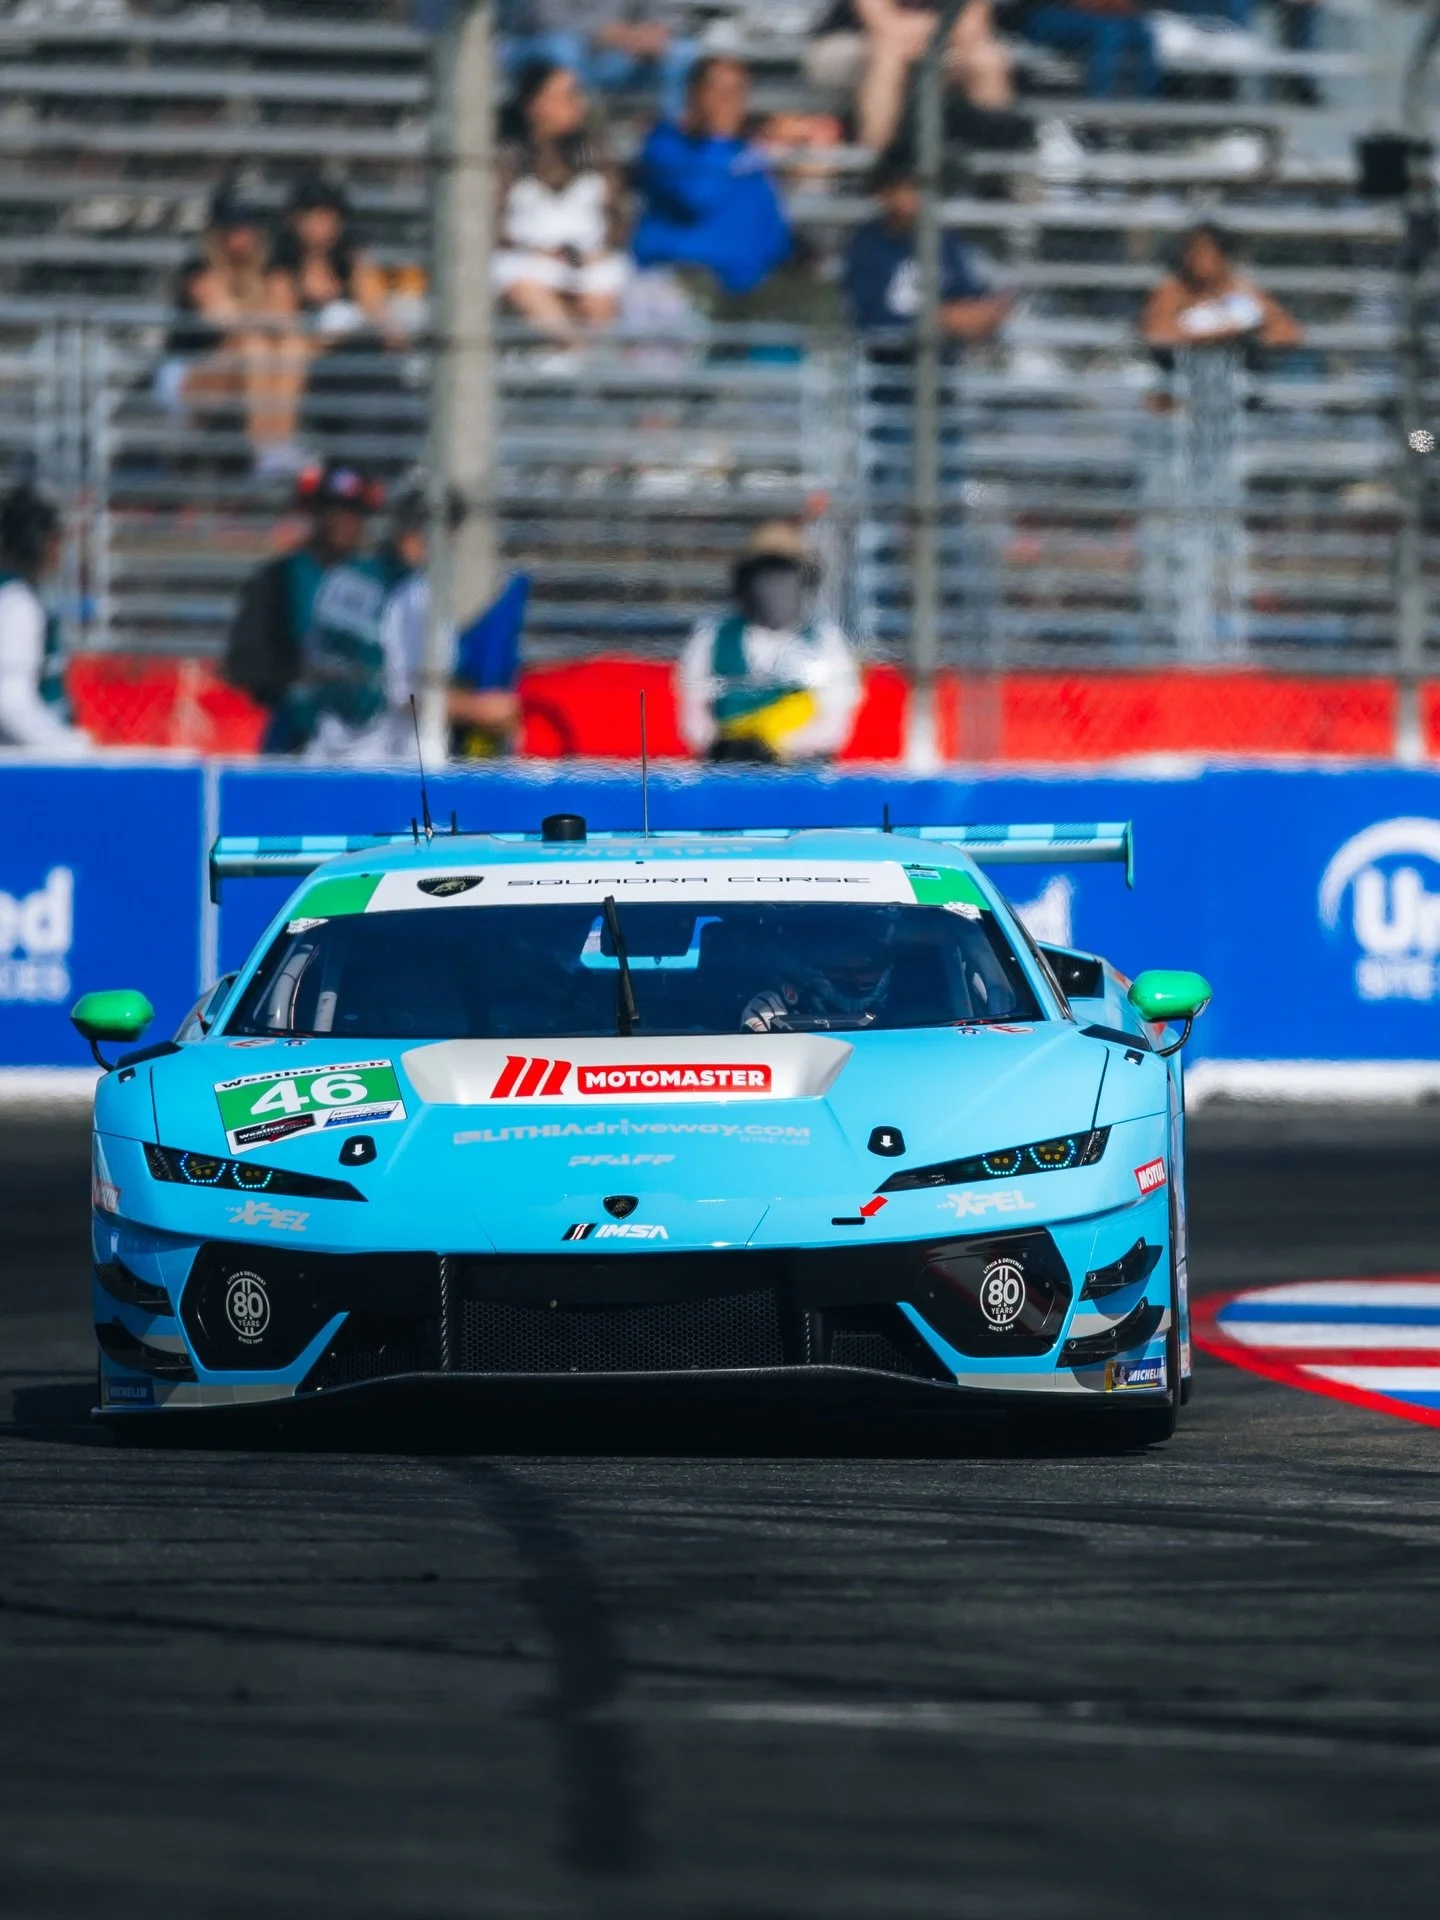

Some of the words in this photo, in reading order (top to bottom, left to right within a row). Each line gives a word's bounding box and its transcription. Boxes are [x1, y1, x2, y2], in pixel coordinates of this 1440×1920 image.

[507, 877, 708, 886] SQUADRA
[727, 876, 871, 884] CORSE
[221, 1060, 387, 1089] WeatherTech
[584, 1069, 765, 1088] MOTOMASTER
[250, 1073, 368, 1116] 46
[568, 1154, 676, 1167] PFAFF
[1137, 1160, 1166, 1190] MOTUL
[228, 1200, 310, 1231] XPEL
[942, 1190, 1037, 1218] XPEL
[595, 1224, 669, 1239] IMSA
[233, 1291, 263, 1318] 80
[988, 1278, 1020, 1305] 80
[238, 1319, 260, 1327] YEARS
[991, 1306, 1014, 1315] YEARS
